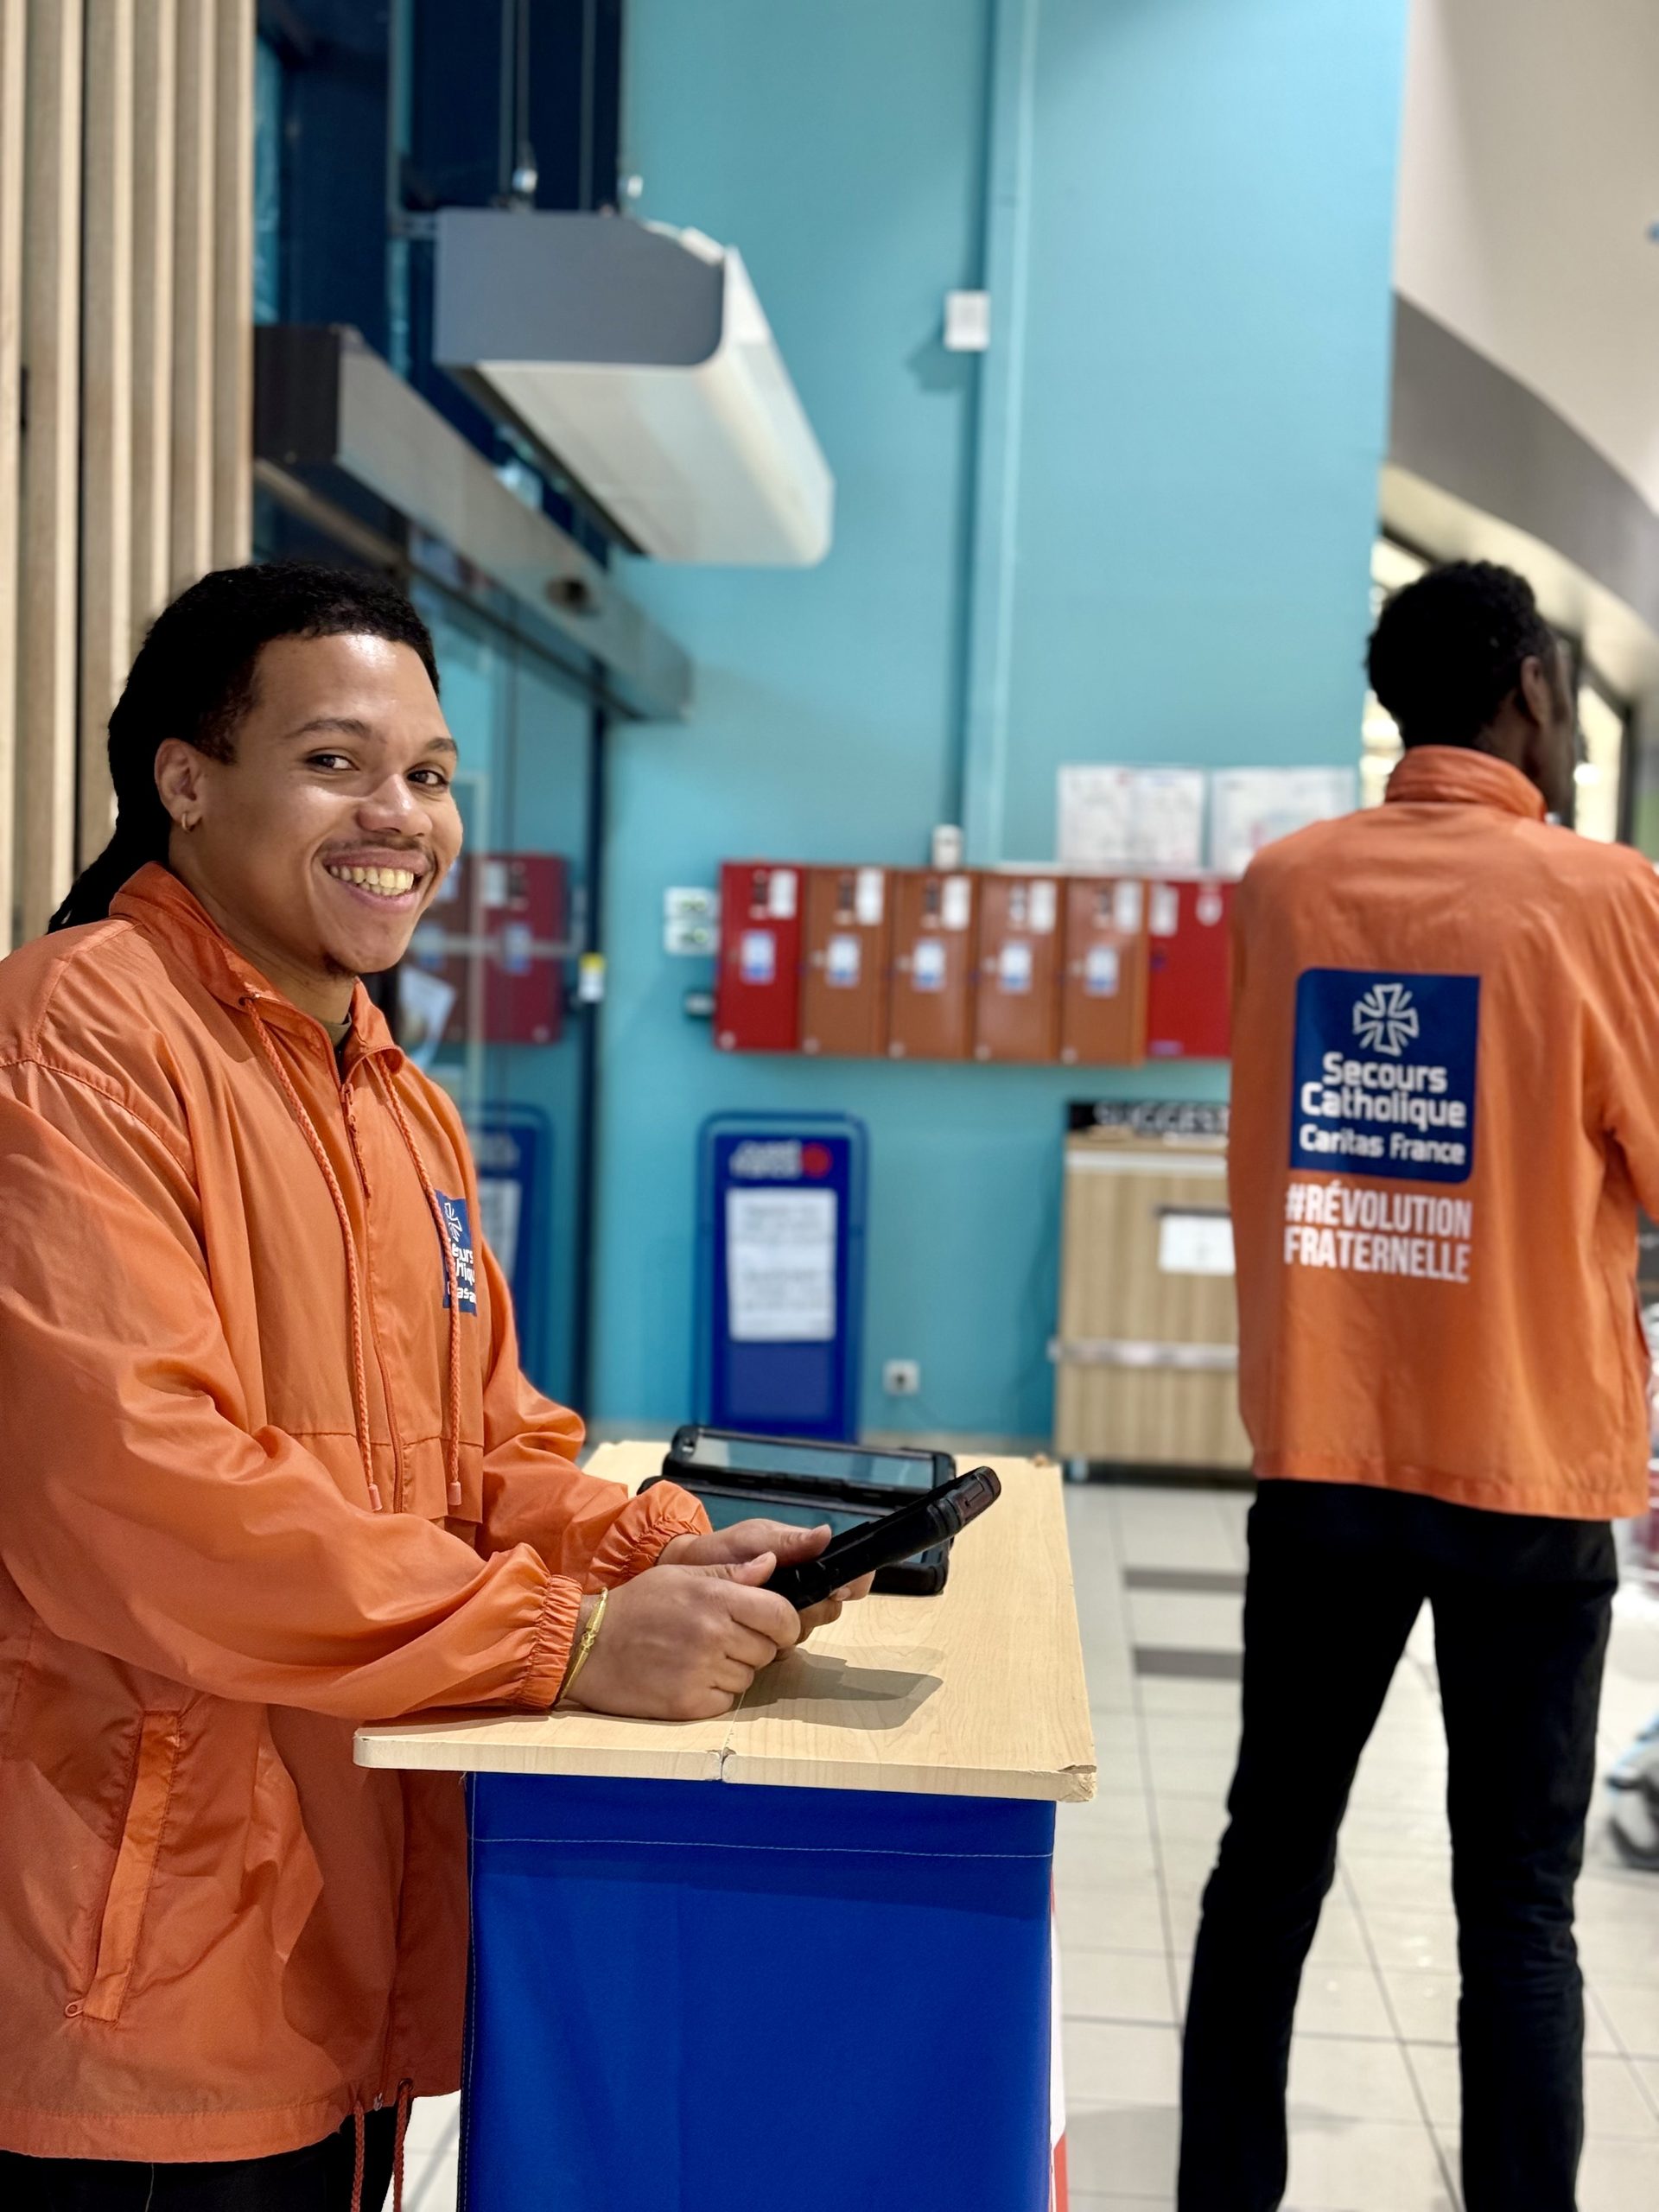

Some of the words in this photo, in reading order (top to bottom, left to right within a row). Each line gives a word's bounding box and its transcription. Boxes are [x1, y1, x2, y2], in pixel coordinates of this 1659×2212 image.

[1322, 1052, 1448, 1094] Secours
[1300, 1081, 1466, 1132] Catholique
[1299, 1123, 1384, 1158] Caritas
[1390, 1132, 1465, 1165] France
[1285, 1179, 1472, 1239] #RÉVOLUTION
[1283, 1224, 1471, 1283] FRATERNELLE
